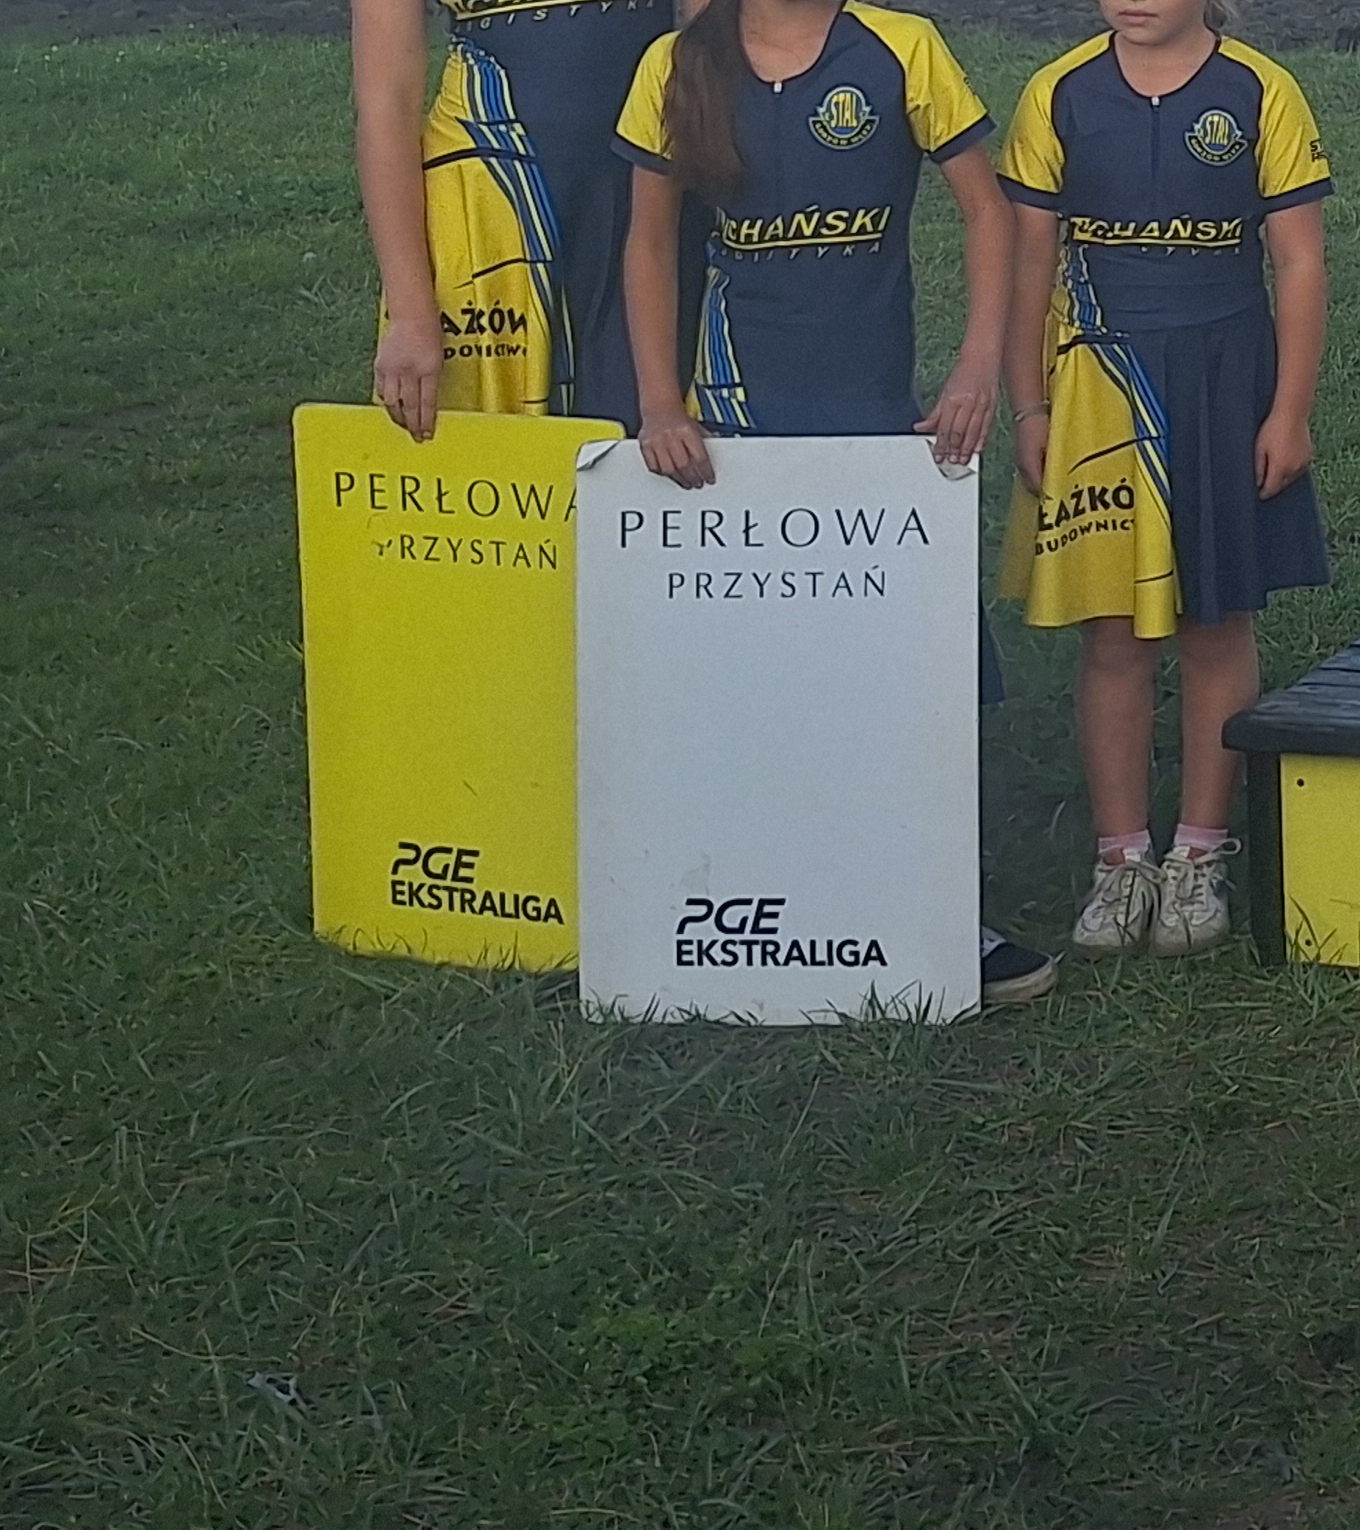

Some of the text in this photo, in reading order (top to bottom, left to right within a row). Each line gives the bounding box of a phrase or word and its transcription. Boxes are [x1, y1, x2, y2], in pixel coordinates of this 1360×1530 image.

[829, 91, 859, 129] STAL
[439, 299, 529, 337] AŻKÓW
[618, 506, 931, 549] PERŁOWA
[1034, 517, 1136, 556] BUDOWNIC
[667, 564, 888, 599] PRZYSTAŃ
[390, 841, 480, 884] PGE
[390, 879, 565, 926] EKSTRALIGA
[676, 896, 787, 935] PGE
[675, 939, 888, 968] EKSTRALIGA
